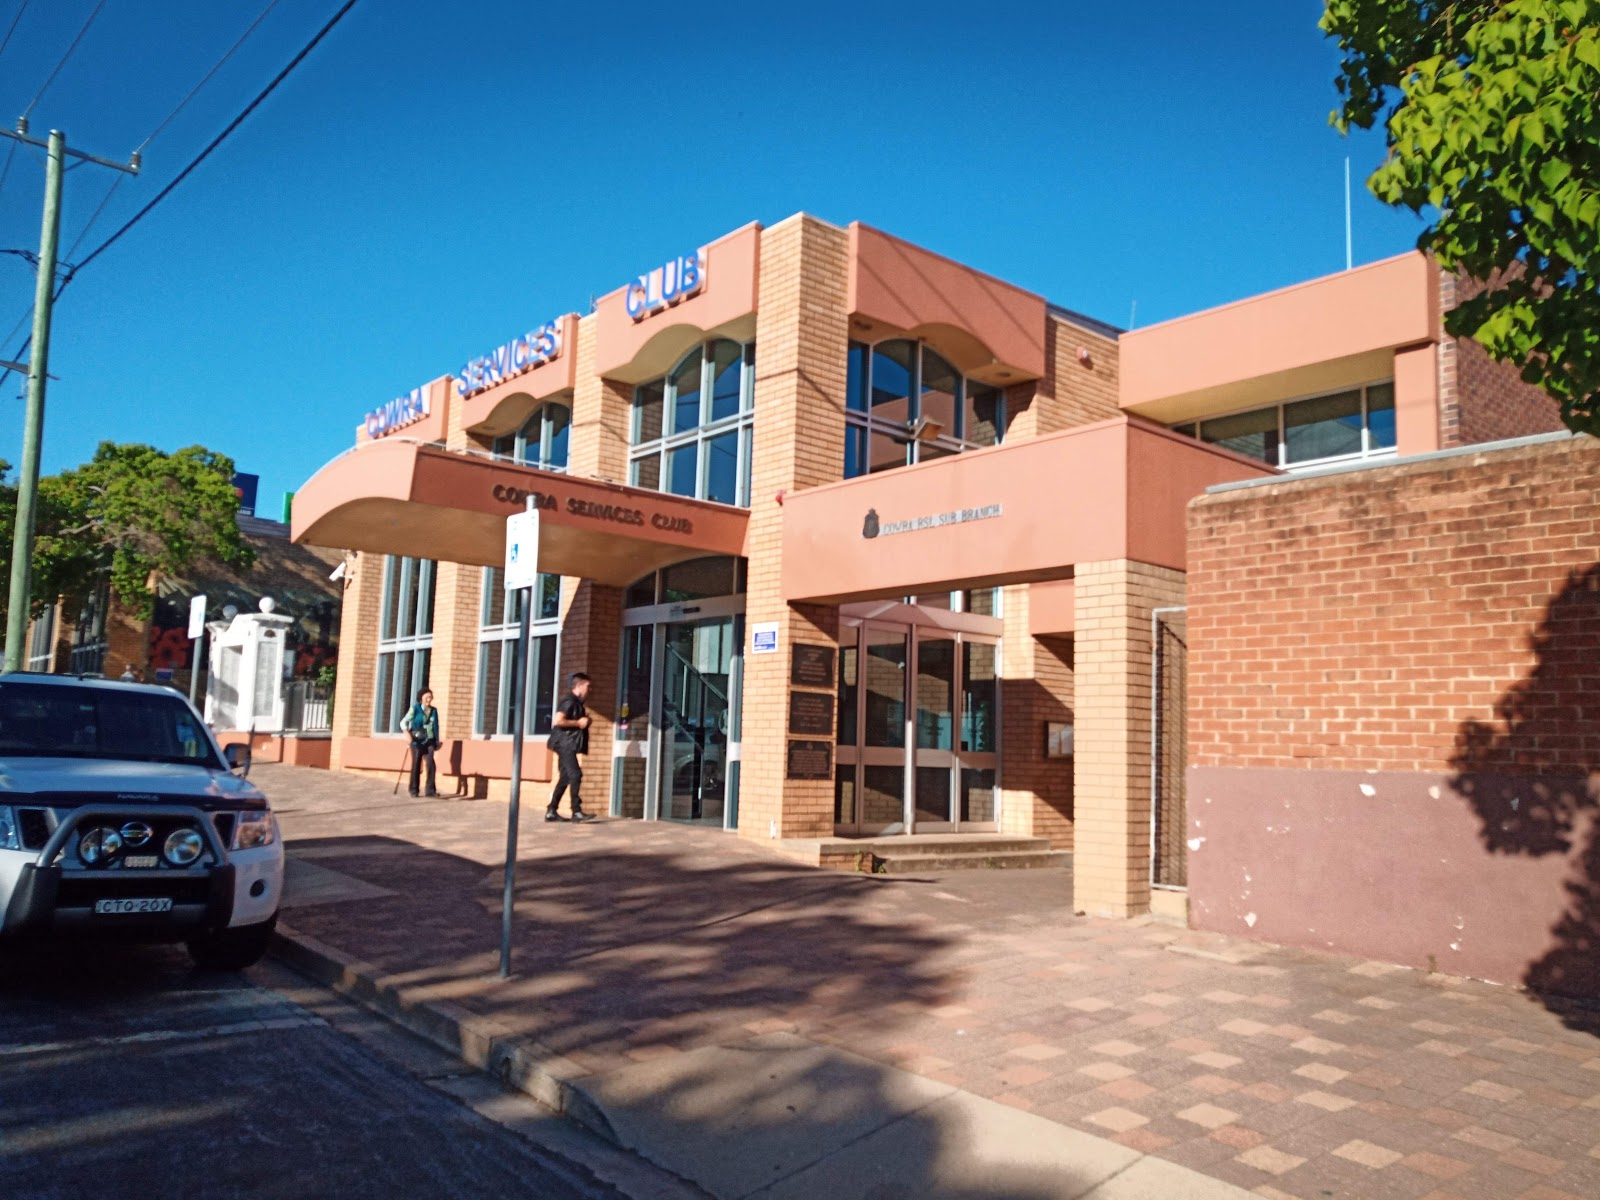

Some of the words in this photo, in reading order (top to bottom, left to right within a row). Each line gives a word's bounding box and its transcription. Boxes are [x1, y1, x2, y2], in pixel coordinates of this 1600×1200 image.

[367, 386, 427, 438] COWRA
[457, 319, 558, 396] SERVICES
[626, 249, 702, 318] CLUB
[566, 497, 645, 527] SERVICES
[651, 512, 694, 535] CLUB
[917, 516, 934, 530] RSL
[938, 512, 958, 525] SUB
[961, 503, 1001, 522] BRANCH
